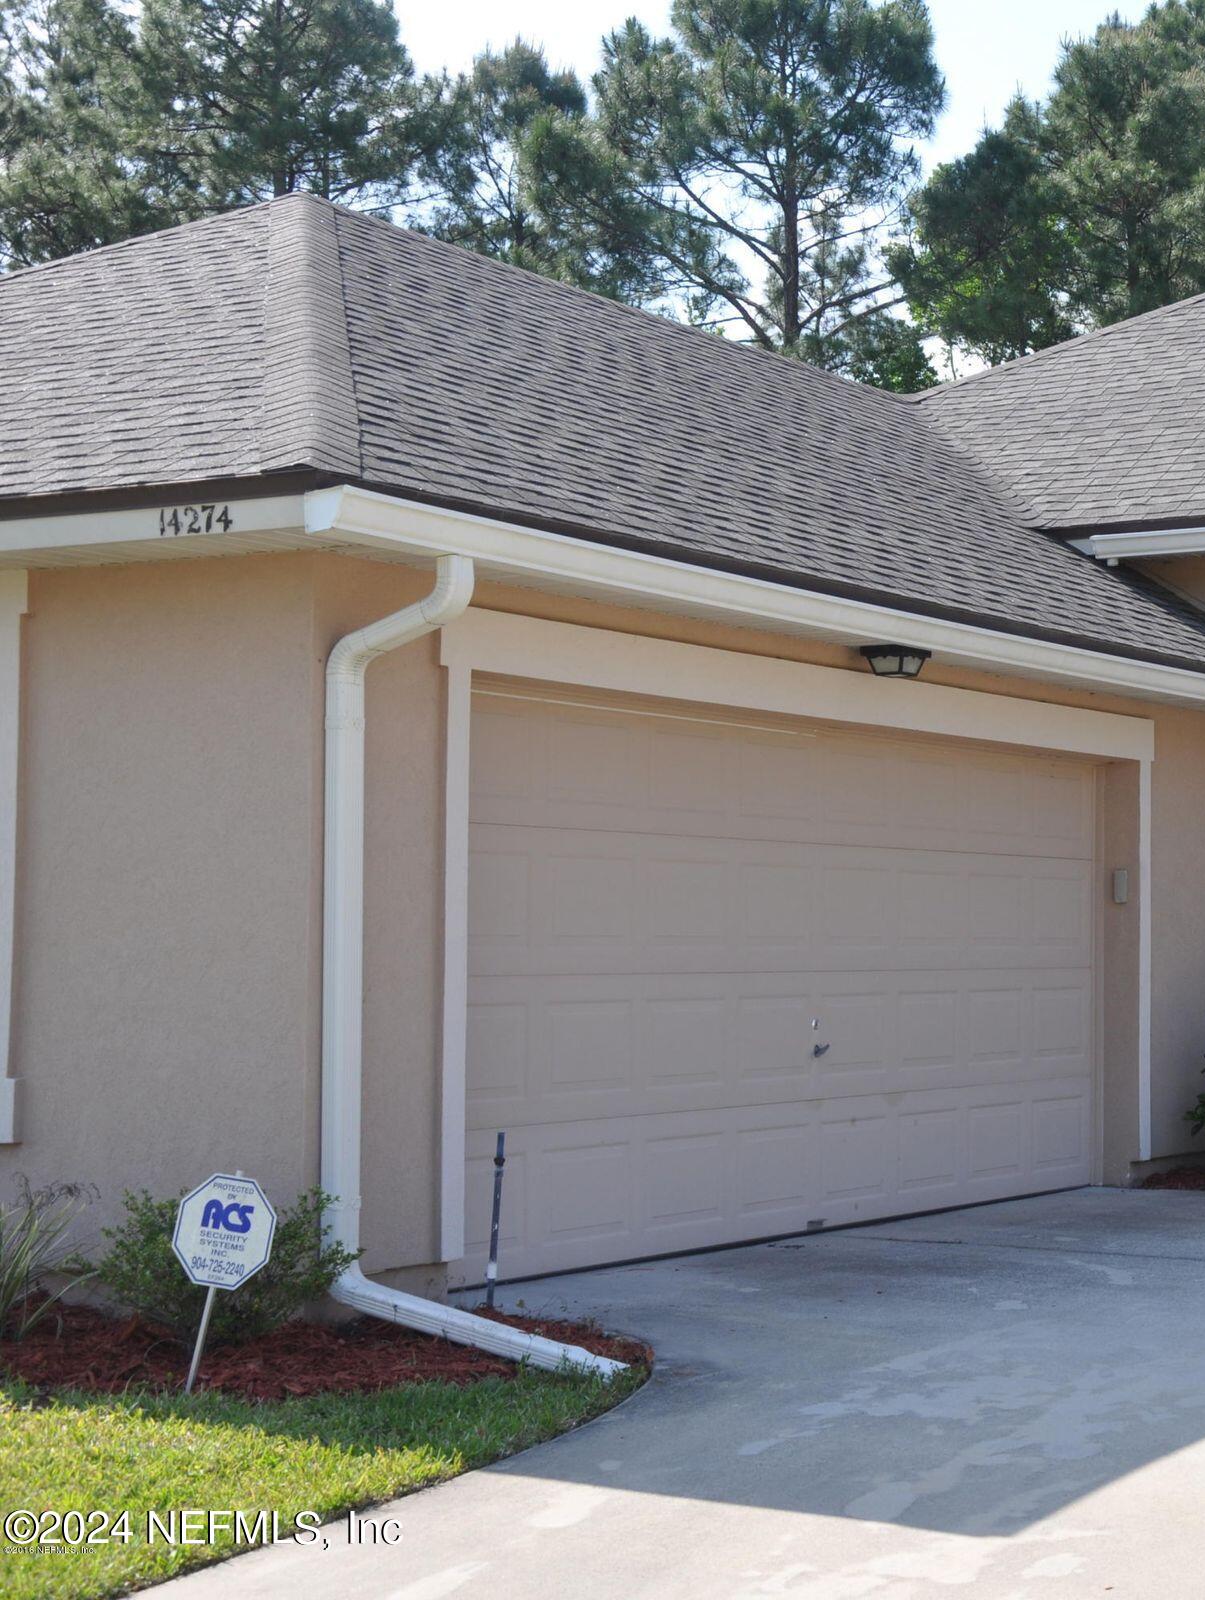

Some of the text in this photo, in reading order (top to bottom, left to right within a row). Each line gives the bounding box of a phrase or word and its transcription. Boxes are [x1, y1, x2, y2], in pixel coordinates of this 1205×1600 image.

[160, 505, 233, 536] 14274
[213, 1182, 254, 1195] PROTECTED
[201, 1199, 254, 1233] ACS
[200, 1230, 248, 1243] SECURITY
[200, 1239, 244, 1252] SYSTEMS
[191, 1256, 245, 1276] 904-725-2240
